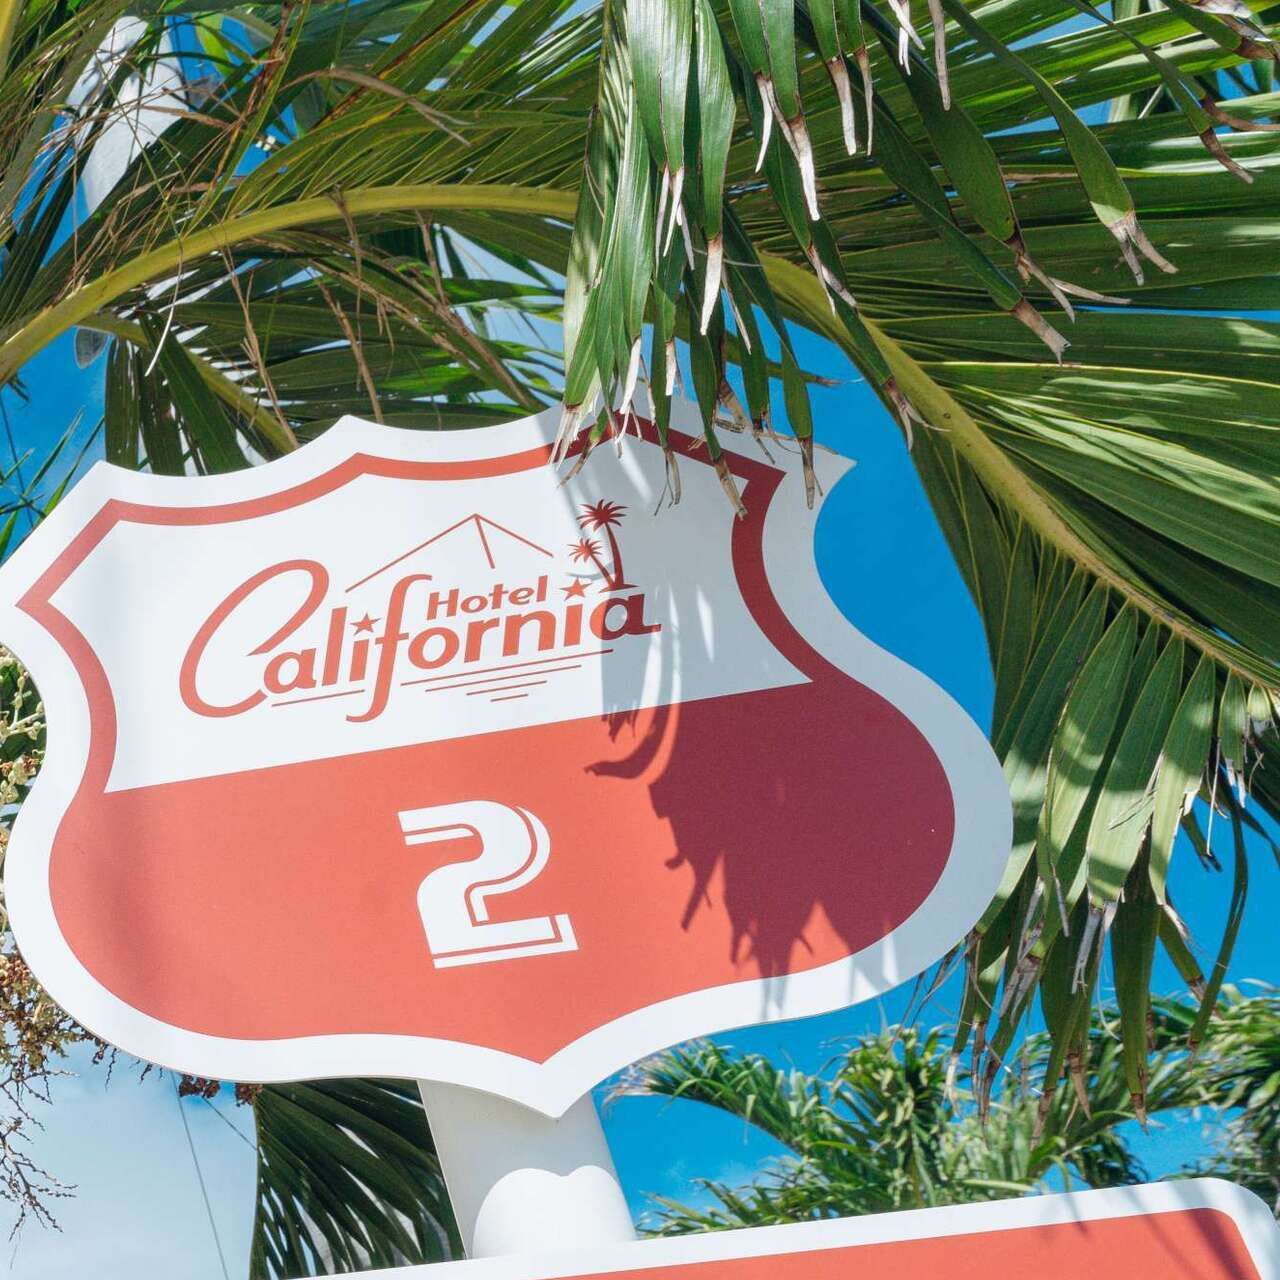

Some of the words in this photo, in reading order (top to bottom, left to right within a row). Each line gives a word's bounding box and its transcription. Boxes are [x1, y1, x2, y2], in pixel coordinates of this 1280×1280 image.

[180, 560, 661, 722] California
[426, 575, 548, 621] Hotel
[398, 801, 579, 969] 2
